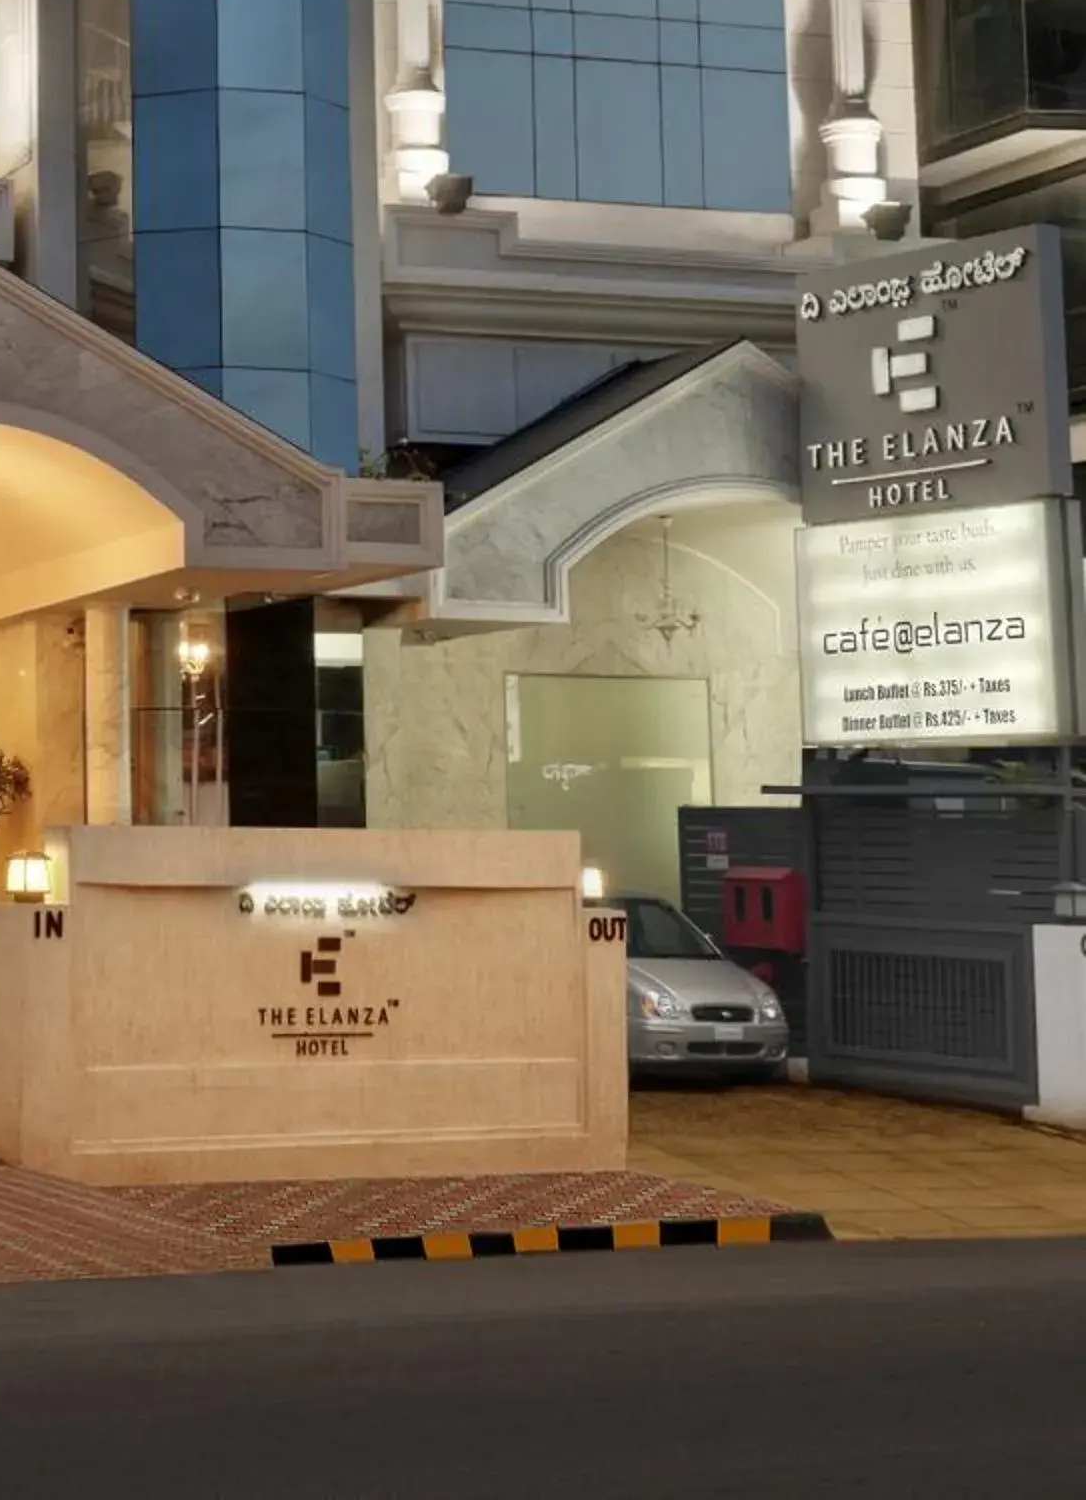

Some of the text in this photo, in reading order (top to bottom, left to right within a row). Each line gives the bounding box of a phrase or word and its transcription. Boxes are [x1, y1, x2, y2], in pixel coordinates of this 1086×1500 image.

[807, 438, 866, 469] THE
[883, 415, 1014, 461] ELANZA
[868, 478, 950, 508] HOTEL
[923, 554, 954, 577] with
[823, 611, 1026, 655] café@elanza
[978, 677, 1011, 694] Taxes
[983, 707, 1016, 725] Taxes
[34, 910, 63, 939] IN
[589, 917, 627, 942] OUT
[258, 1007, 296, 1026] THE
[306, 1007, 389, 1026] ELANZA
[295, 1039, 349, 1057] HOTEL
